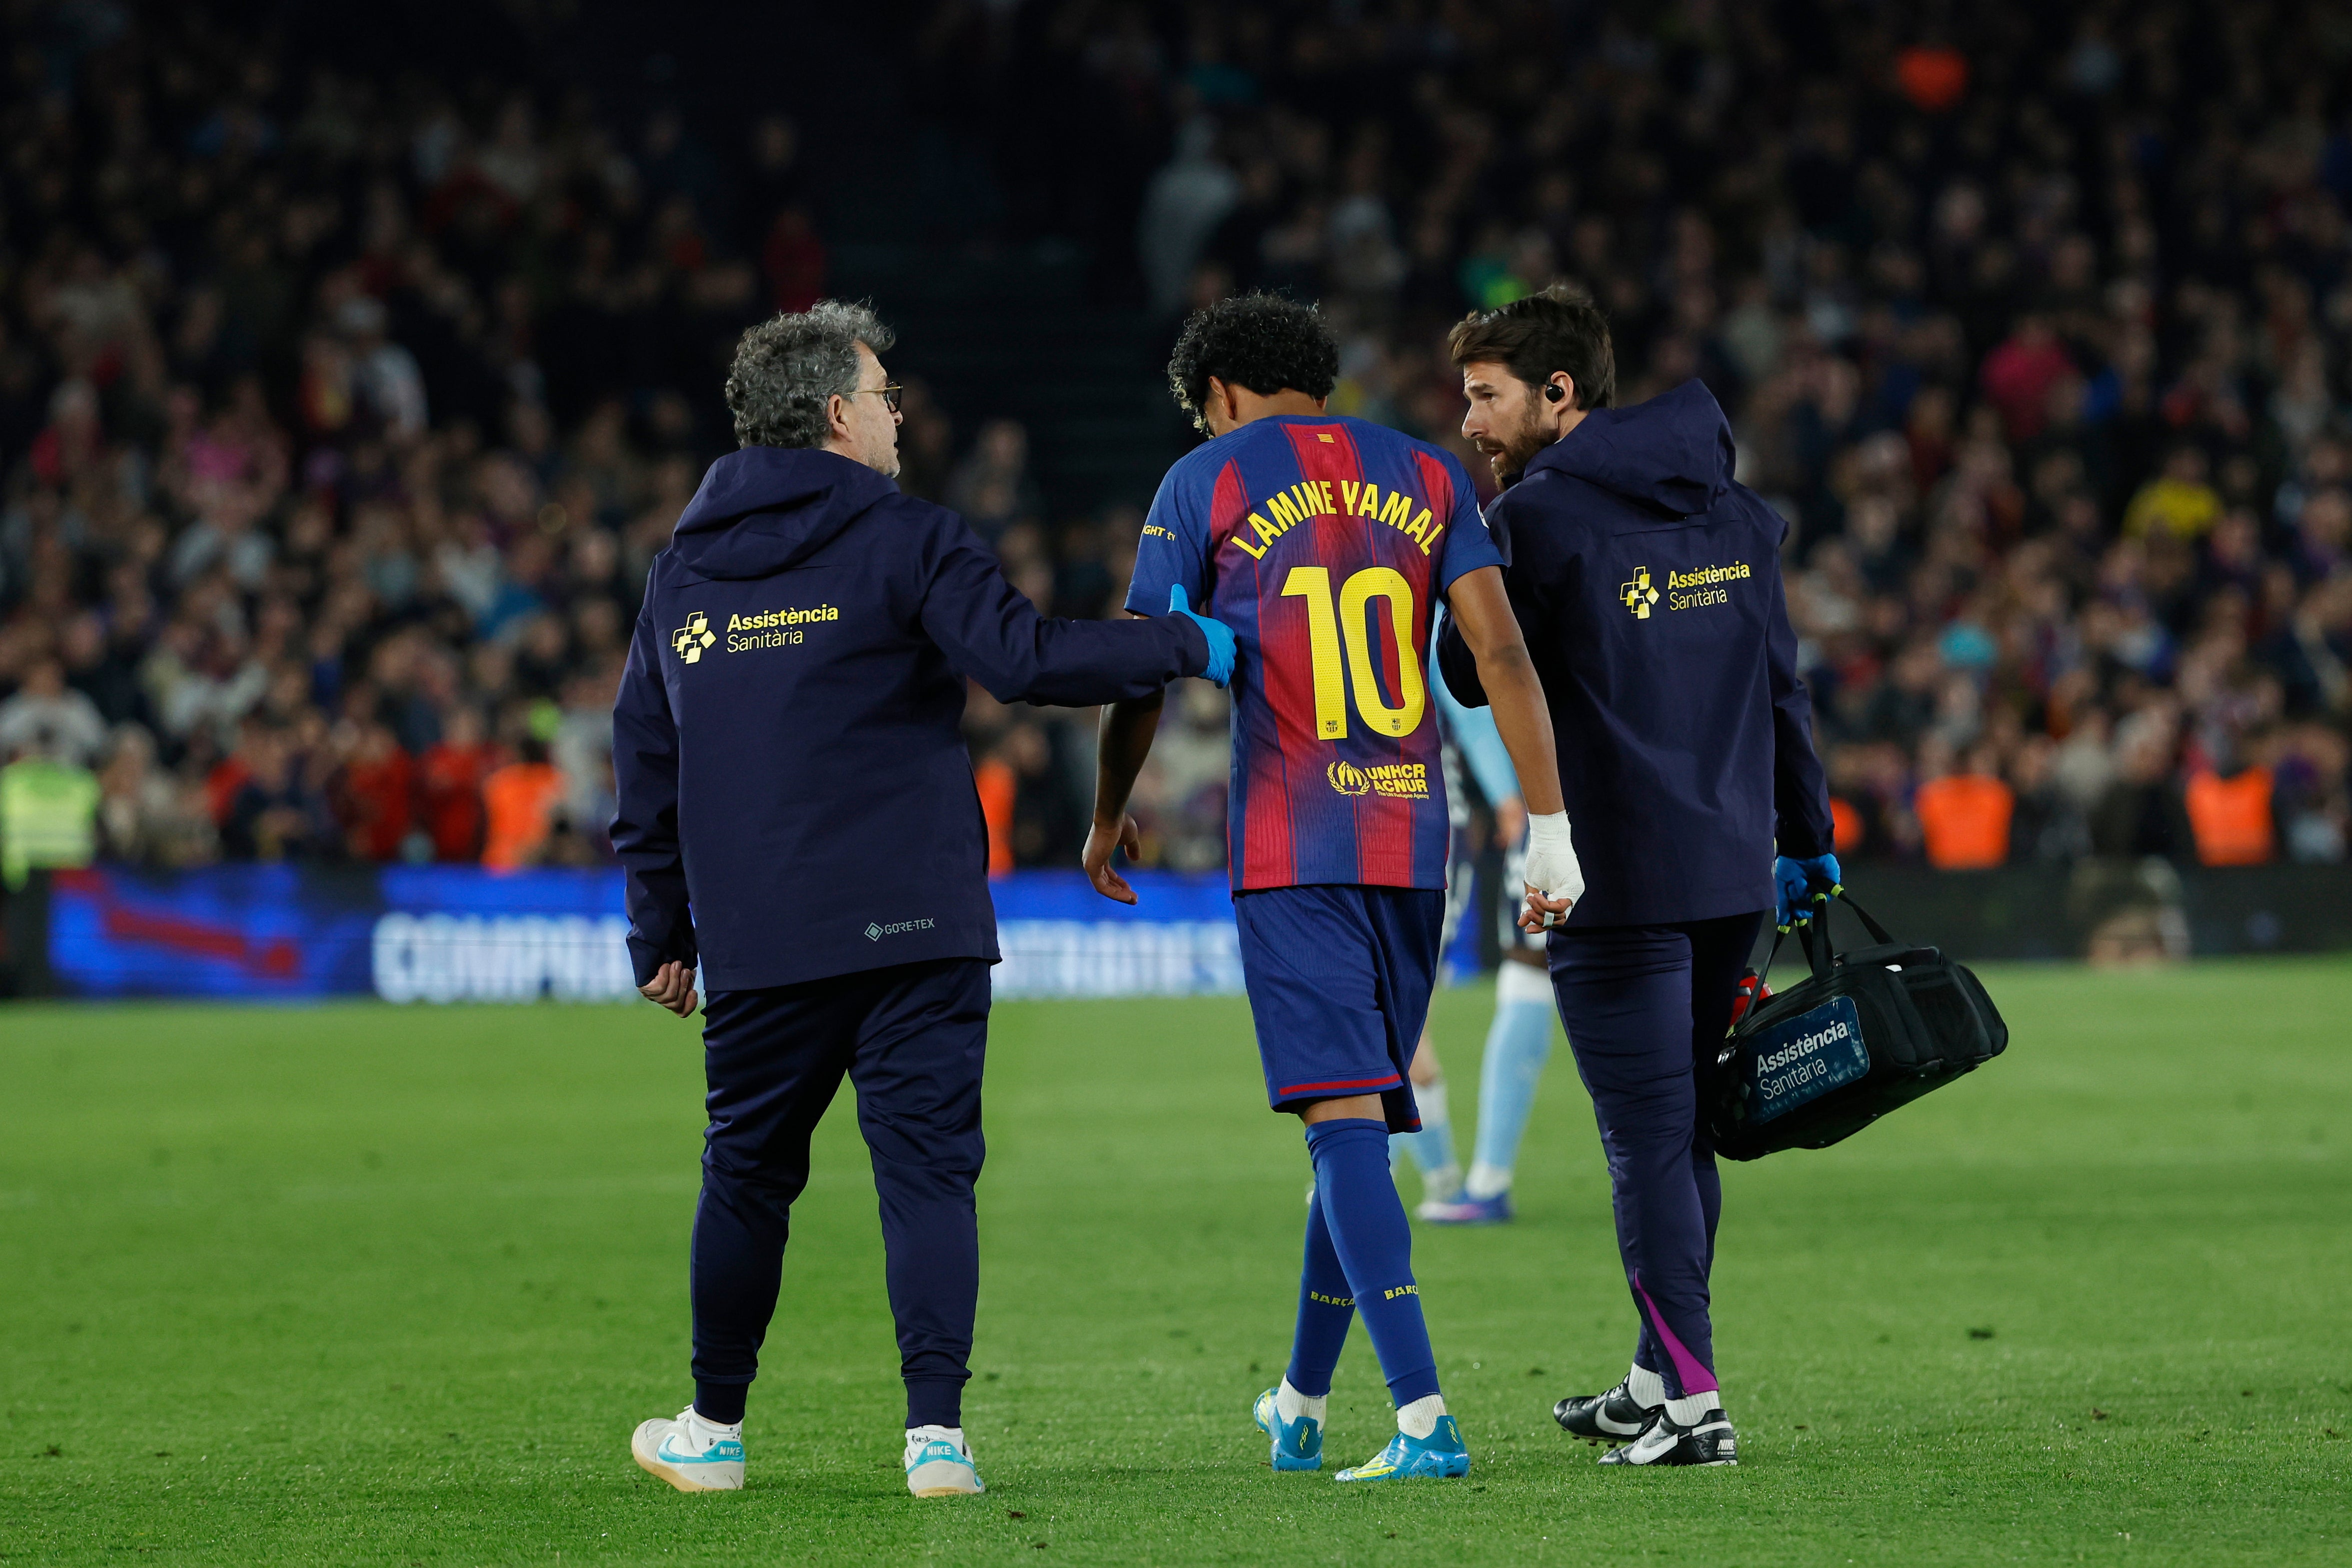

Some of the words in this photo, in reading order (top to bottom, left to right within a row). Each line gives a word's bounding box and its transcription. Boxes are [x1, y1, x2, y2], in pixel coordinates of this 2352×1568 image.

[1142, 524, 1166, 537] GHT
[1231, 480, 1337, 560] LAMINE
[1341, 480, 1444, 556] YAMAL
[1668, 560, 1751, 590] Assistència
[1669, 585, 1728, 611] Sanitària
[726, 604, 839, 633] Assistència
[727, 627, 803, 653] Sanitària
[1280, 566, 1425, 741] 10
[1364, 764, 1426, 780] UNHCR
[1373, 779, 1428, 793] ACNUR
[884, 918, 935, 935] GORE-TEX
[1757, 1020, 1849, 1078] Assistència
[1760, 1056, 1828, 1100] Sanitària
[1310, 1291, 1355, 1307] BARÇA
[719, 1446, 741, 1456] NIKE
[926, 1445, 951, 1456] NIKE
[1717, 1439, 1735, 1451] NIKE
